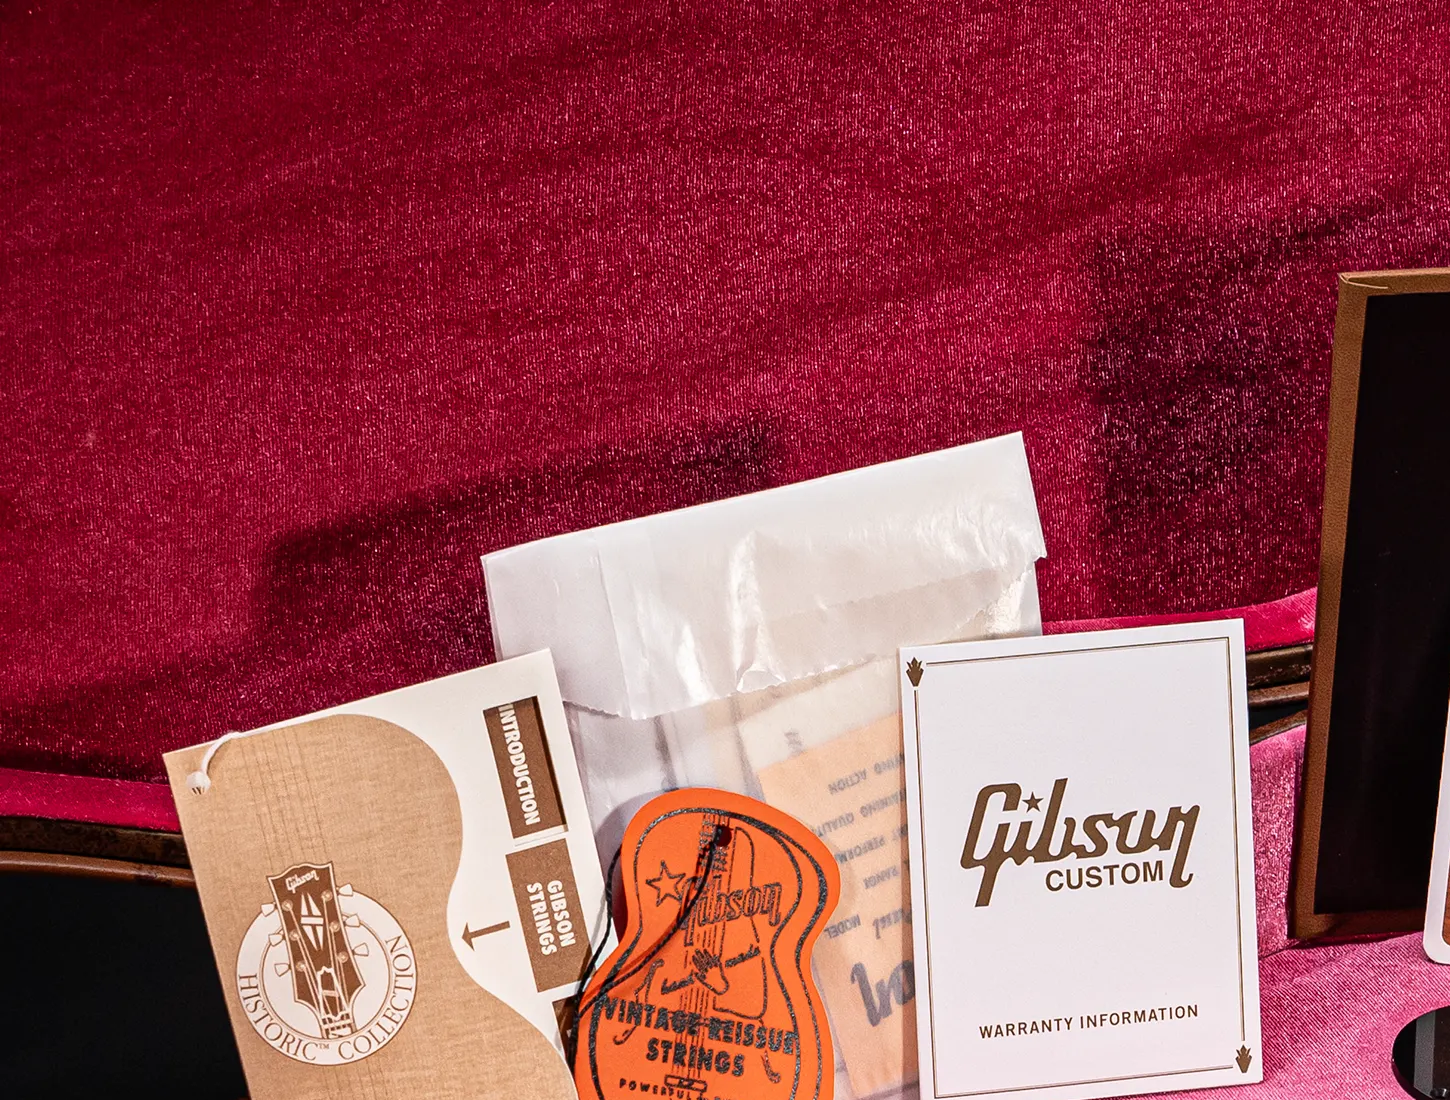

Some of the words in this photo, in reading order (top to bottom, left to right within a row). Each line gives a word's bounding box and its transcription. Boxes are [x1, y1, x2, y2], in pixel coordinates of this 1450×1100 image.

[498, 703, 541, 826] INTRODUCTION
[960, 777, 1200, 908] Gibson
[1045, 861, 1164, 892] CUSTOM
[527, 882, 558, 957] STRINGS
[547, 880, 577, 948] GIBSON
[680, 876, 783, 947] Gibson
[338, 935, 414, 1061] COLLECTION
[600, 995, 701, 1037] VINTAGE
[708, 1015, 797, 1056] REISSUE
[979, 1017, 1073, 1039] WARRANTY
[1080, 1003, 1199, 1030] INFORMATION
[619, 1078, 691, 1100] POWERFUL
[646, 1037, 745, 1077] STRINGS
